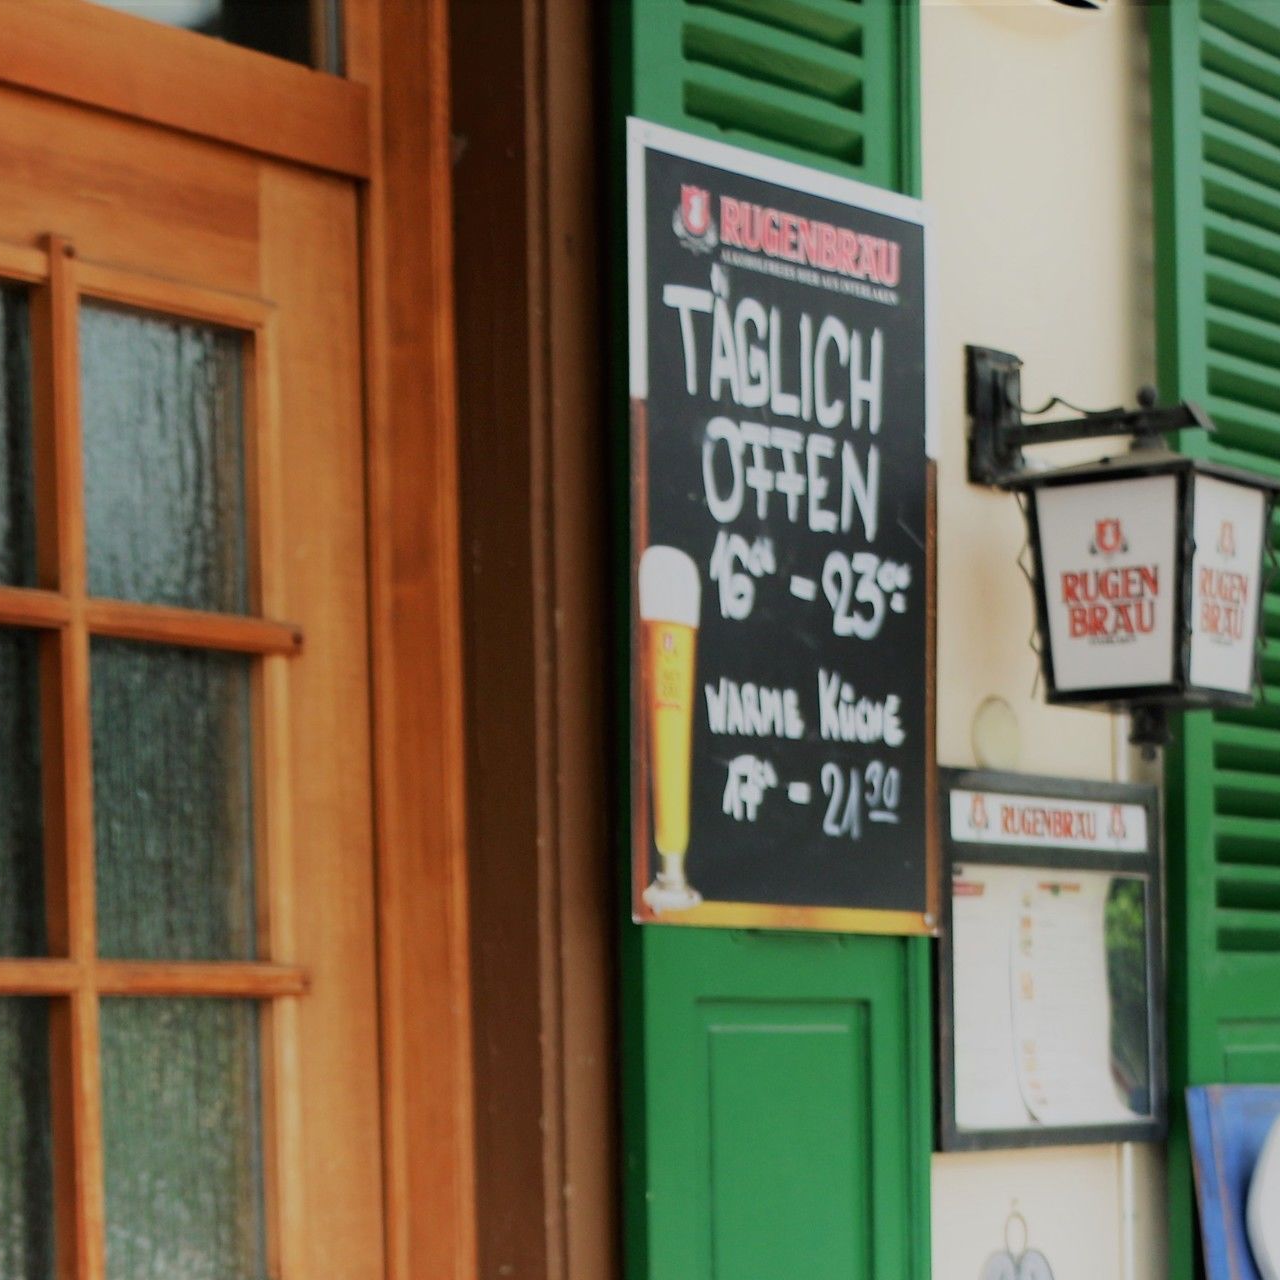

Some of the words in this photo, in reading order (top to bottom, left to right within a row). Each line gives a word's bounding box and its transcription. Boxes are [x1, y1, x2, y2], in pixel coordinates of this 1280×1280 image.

[663, 262, 884, 434] TÄGLICH
[702, 416, 880, 542] OFFEN
[1061, 565, 1158, 606] RUGEN
[1199, 567, 1249, 606] RUGEN
